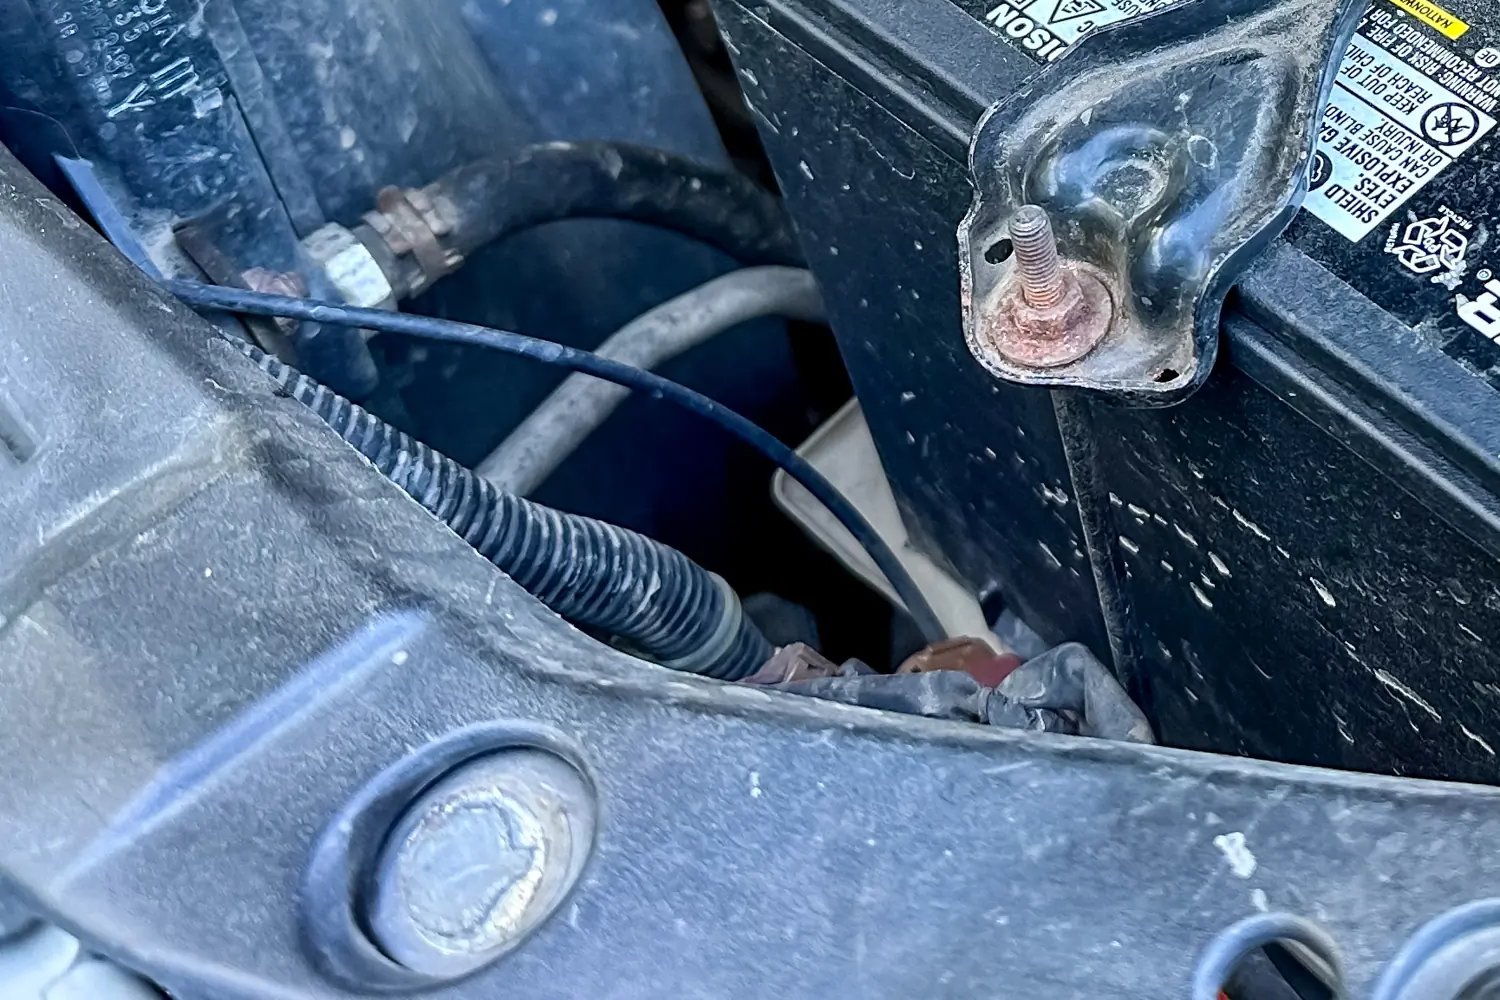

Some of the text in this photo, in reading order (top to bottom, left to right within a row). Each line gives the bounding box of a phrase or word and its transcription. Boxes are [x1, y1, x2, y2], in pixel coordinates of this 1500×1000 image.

[1366, 22, 1398, 48] FIRE,
[1369, 8, 1399, 29] FOR
[1390, 42, 1413, 58] OF
[1393, 23, 1482, 82] RECOMMENDED
[1407, 51, 1441, 76] RISK
[1477, 50, 1498, 65] DE
[1339, 42, 1433, 104] REACH OF CHIL
[1339, 64, 1419, 116] KEEP OUT OF
[1438, 69, 1497, 112] WARNING:
[1318, 102, 1365, 135] BLIND
[1358, 129, 1403, 161] CAUSE
[1374, 118, 1443, 167] OR INJURY.
[1333, 137, 1414, 194] EXPLOSIVE
[1398, 156, 1430, 179] CAN
[1324, 184, 1379, 224] SHIELD
[1354, 173, 1397, 209] EYES.
